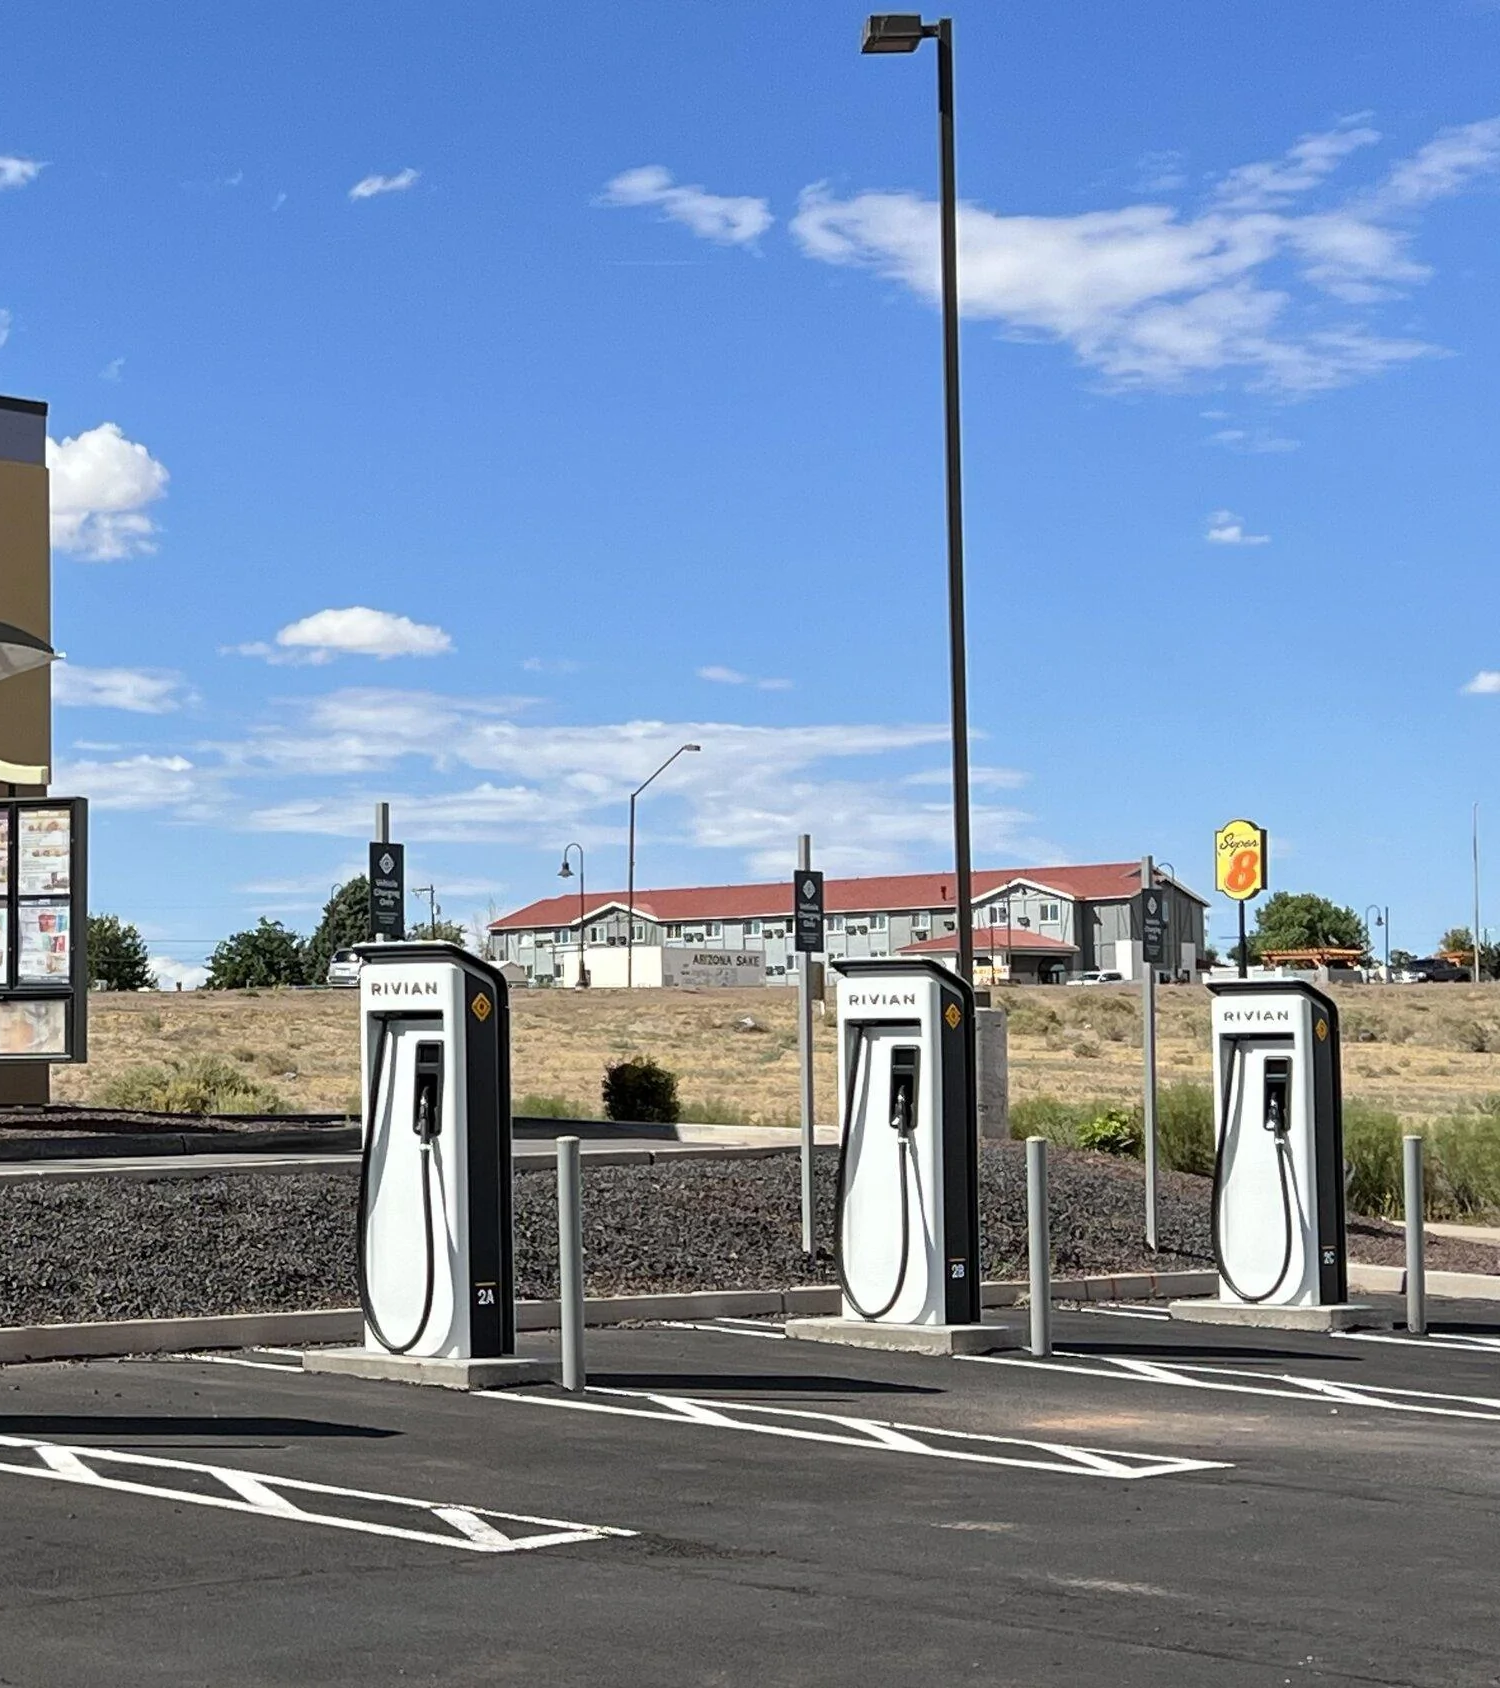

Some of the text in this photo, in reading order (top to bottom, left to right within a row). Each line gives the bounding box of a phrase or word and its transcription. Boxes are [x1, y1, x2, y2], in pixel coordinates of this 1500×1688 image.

[1220, 833, 1259, 857] Super
[1225, 850, 1258, 893] 8
[371, 982, 438, 996] RIVIAN
[849, 993, 915, 1006] RIVIAN
[1224, 1010, 1289, 1021] RIVIAN
[477, 1289, 495, 1305] 2A
